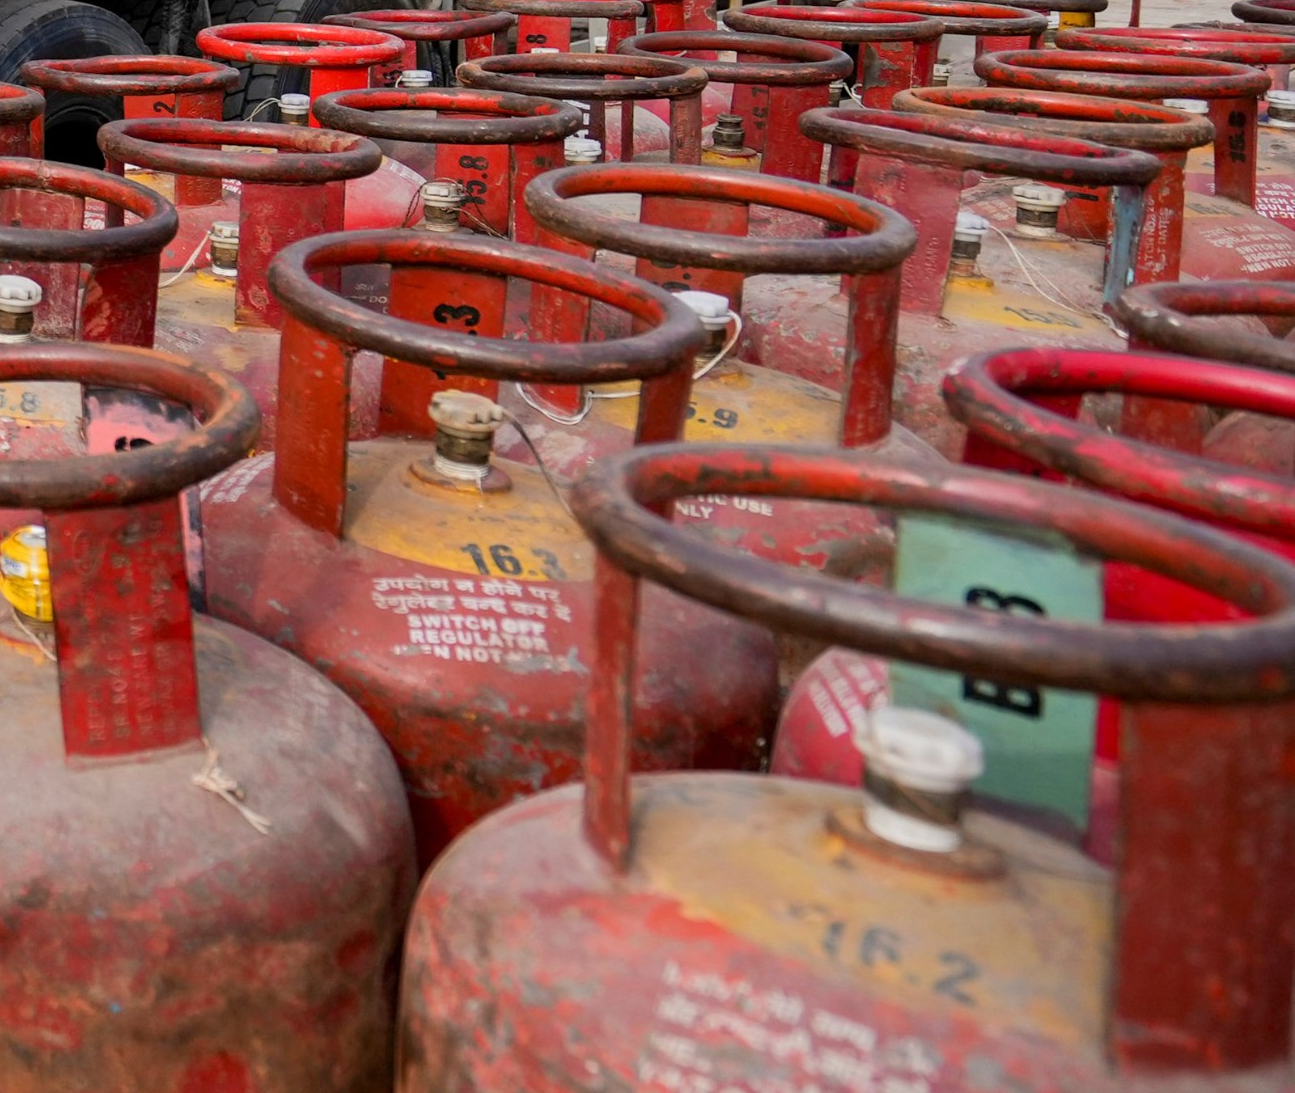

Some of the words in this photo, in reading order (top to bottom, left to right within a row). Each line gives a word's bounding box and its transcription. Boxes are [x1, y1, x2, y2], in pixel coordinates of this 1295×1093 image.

[732, 496, 773, 517] USE
[460, 543, 567, 581] 16.3
[407, 614, 497, 633] SWITCH
[501, 618, 545, 636] OFF
[409, 629, 549, 653] REGULATOR
[455, 645, 502, 664] NOT
